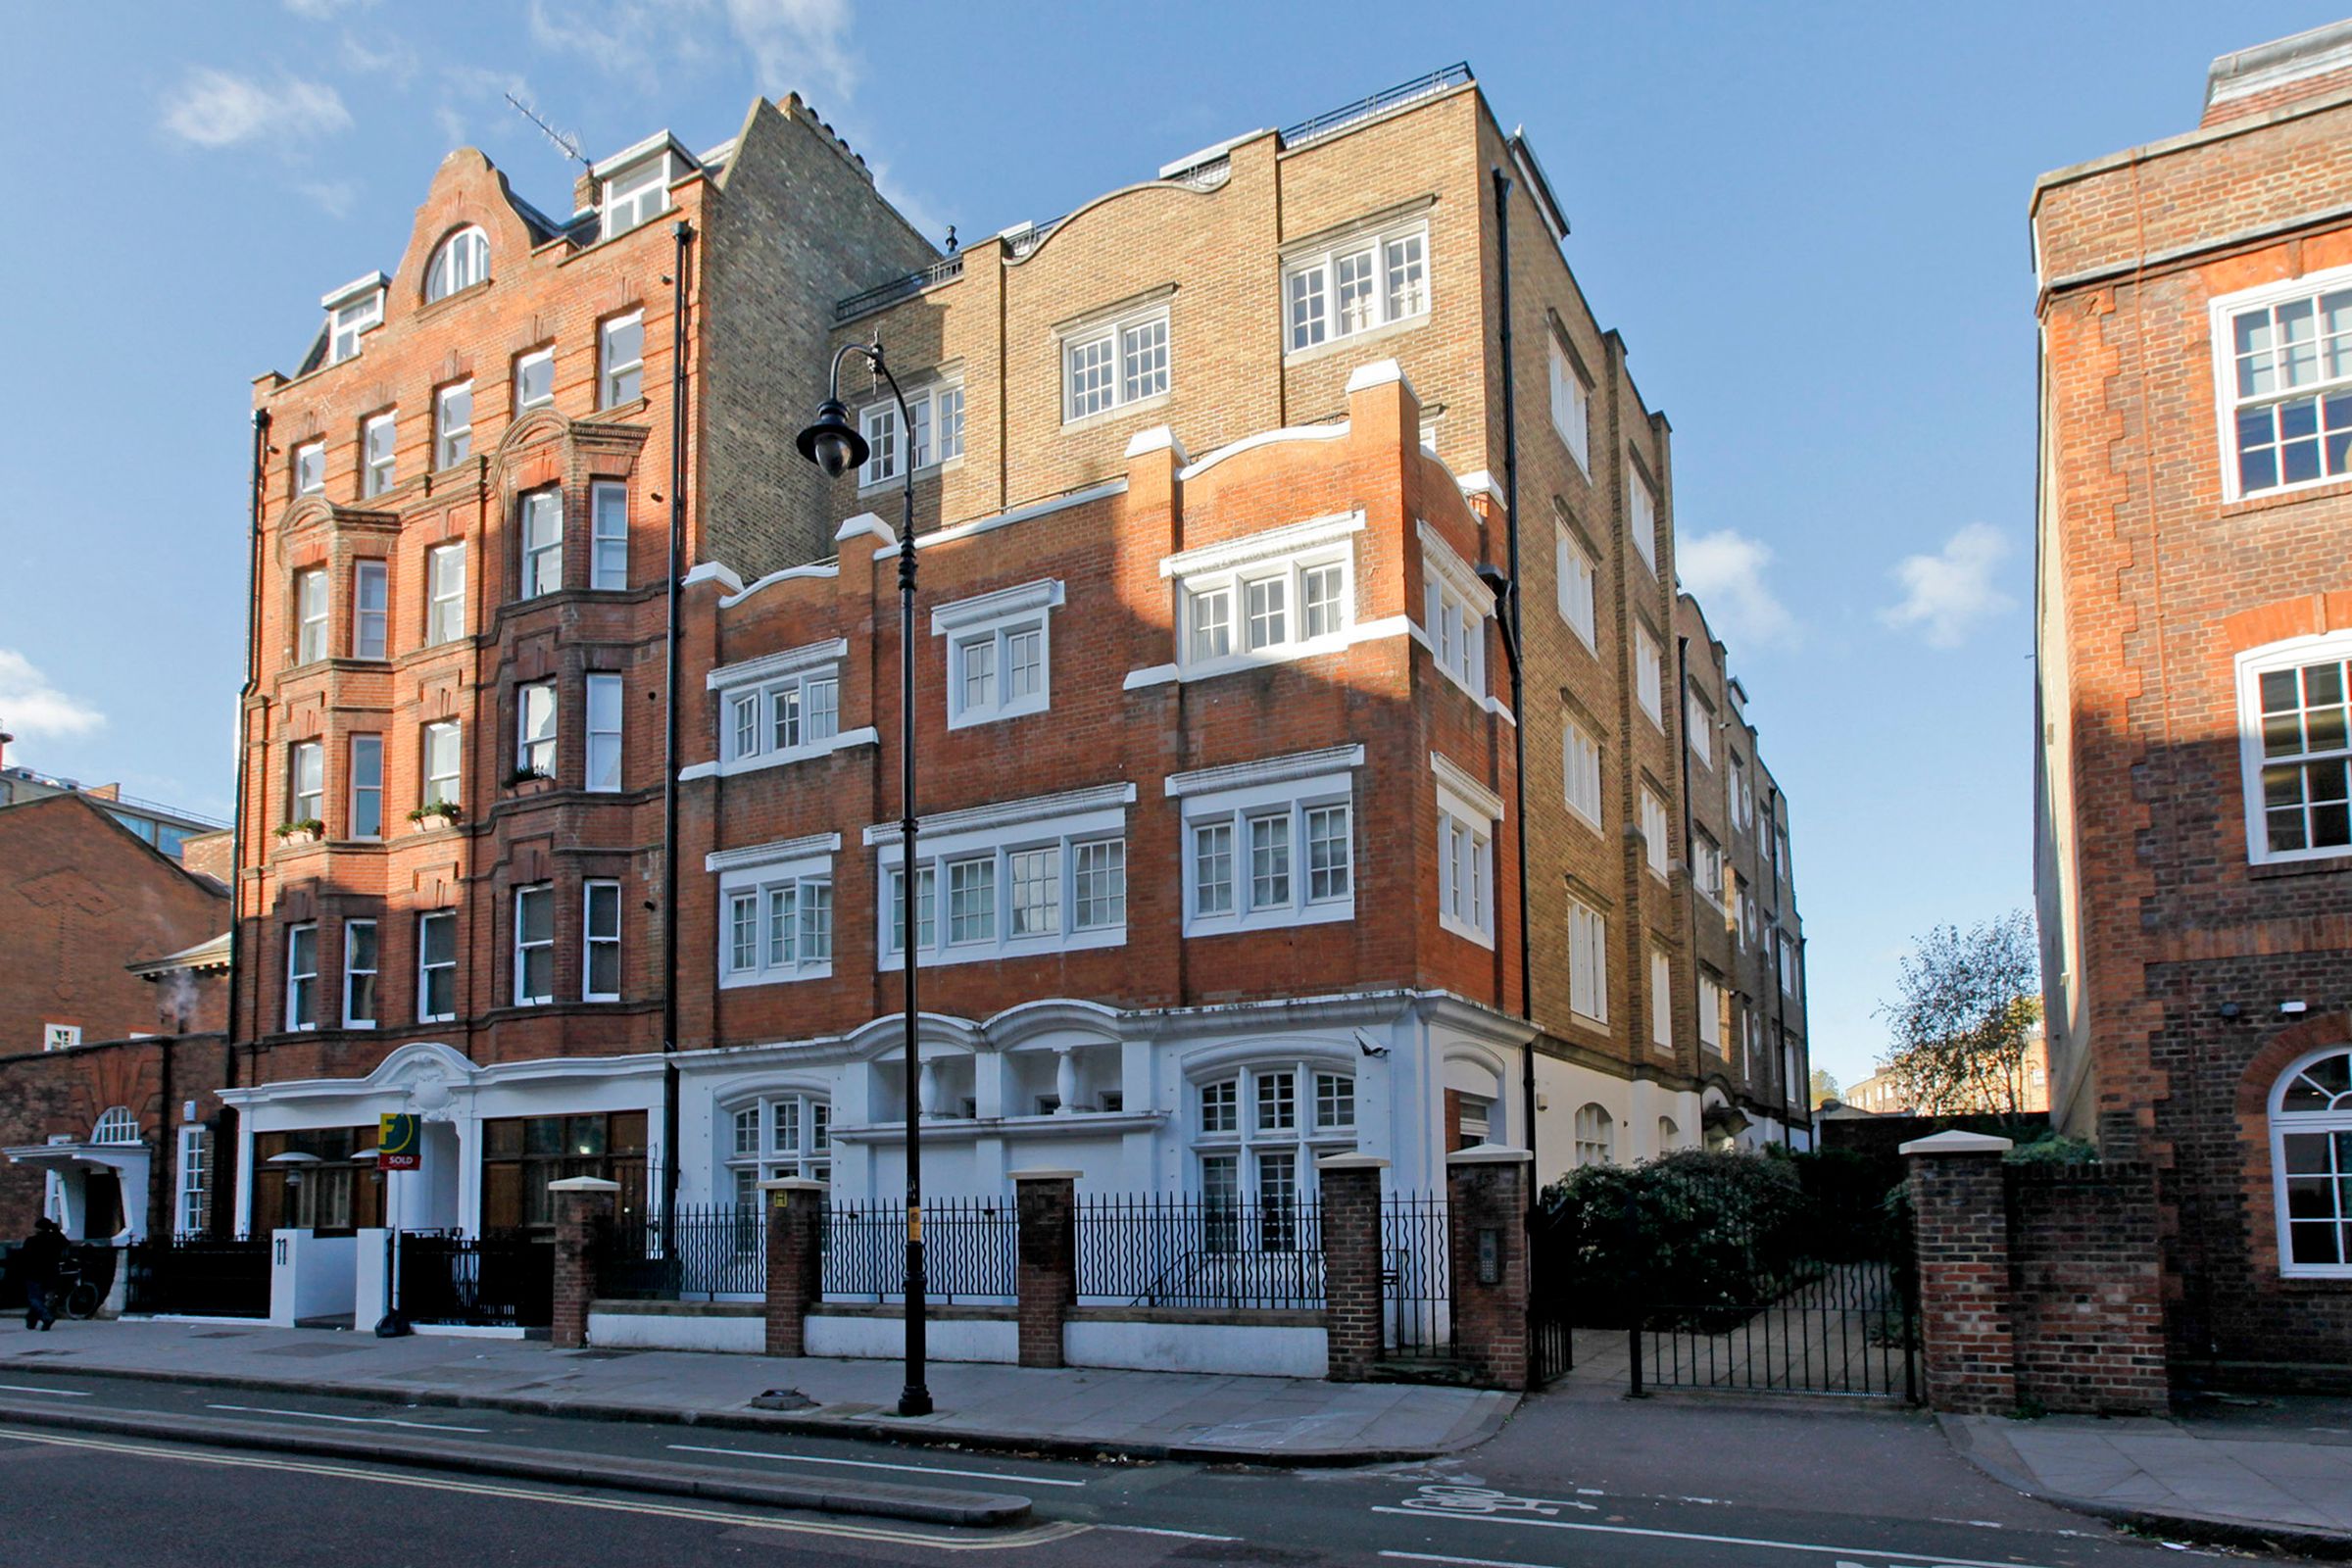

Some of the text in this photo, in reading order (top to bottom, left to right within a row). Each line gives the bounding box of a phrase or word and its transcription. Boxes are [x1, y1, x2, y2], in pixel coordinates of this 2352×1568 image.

[388, 1155, 414, 1165] SOLD
[775, 1192, 785, 1205] H
[275, 1238, 288, 1265] 11
